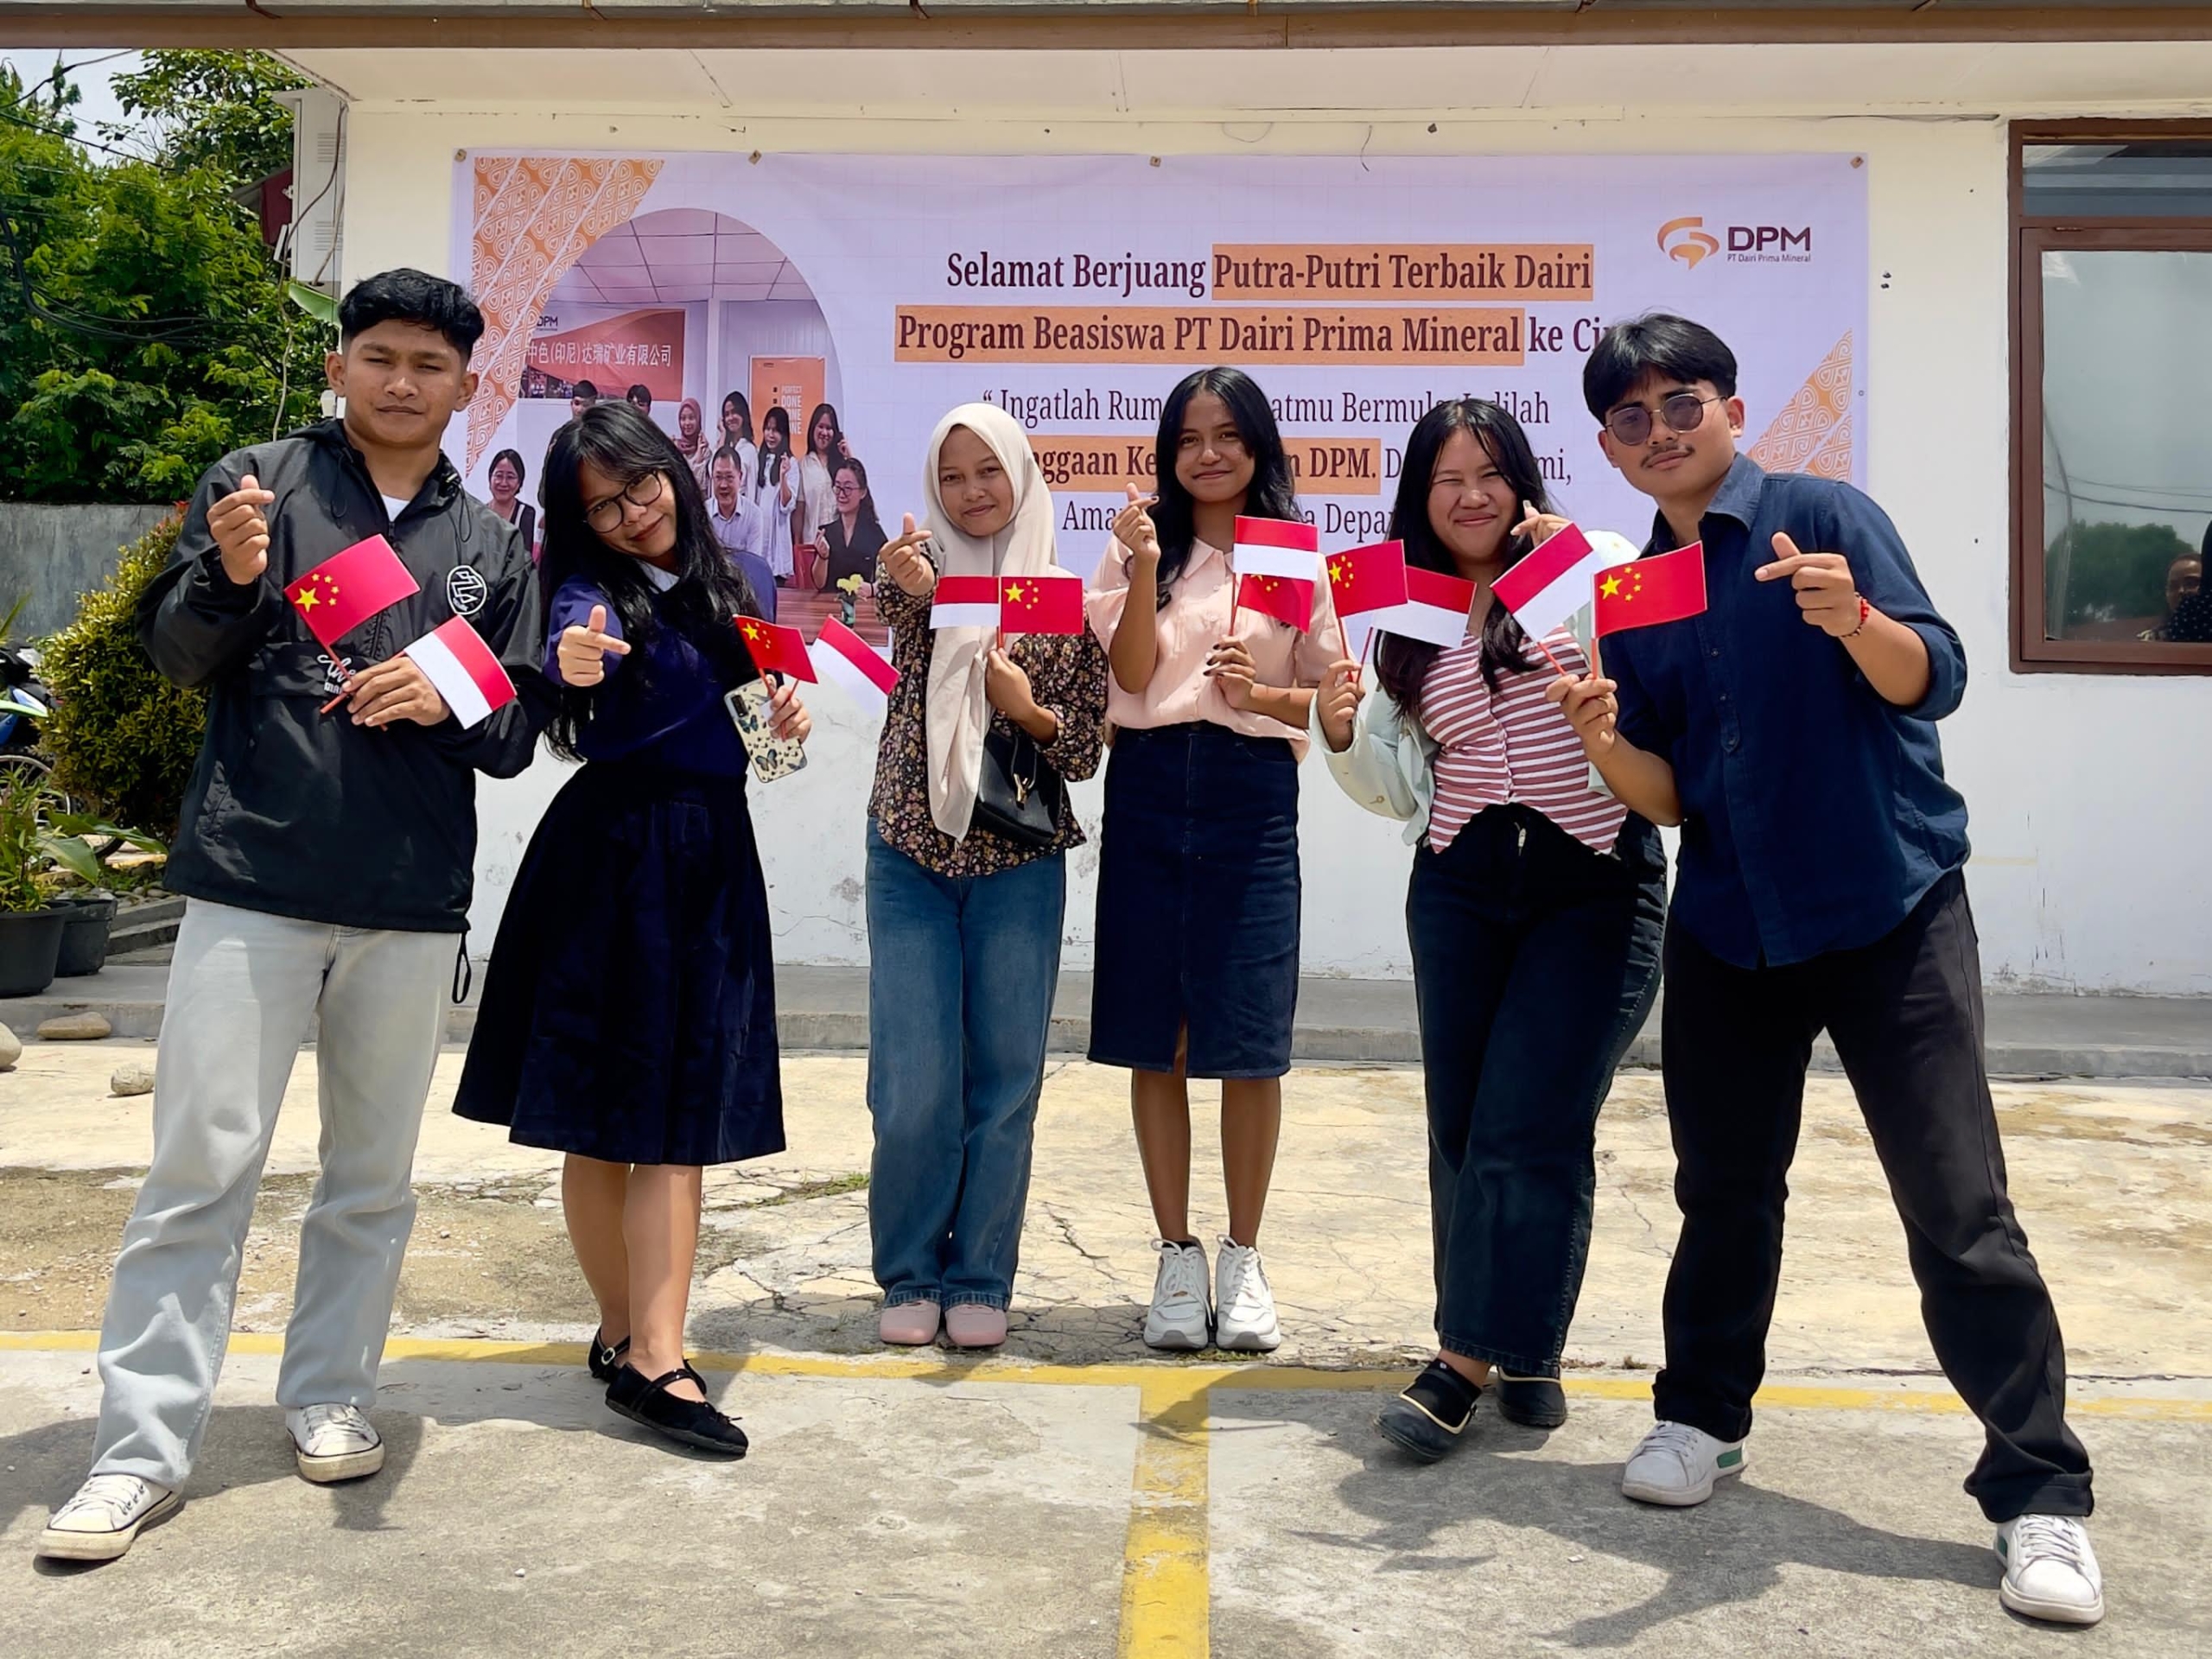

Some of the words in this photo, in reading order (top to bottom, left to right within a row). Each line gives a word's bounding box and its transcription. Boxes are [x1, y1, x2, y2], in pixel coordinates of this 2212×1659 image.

[1728, 226, 1810, 251] DPM
[1782, 253, 1811, 262] Mineral
[947, 251, 1065, 288] Selamat
[1072, 252, 1206, 298] Berjuang
[1213, 252, 1381, 289] Putra-Putri
[1389, 252, 1506, 289] Terbaik
[1514, 252, 1591, 289] Dairi
[899, 315, 1025, 359] Program
[1033, 315, 1166, 350] Beasiswa
[1173, 317, 1211, 351] PT
[1219, 315, 1294, 351] Dairi
[1303, 315, 1393, 352] Prima
[1402, 316, 1521, 352] Mineral
[1528, 316, 1563, 353] ke
[1573, 316, 1609, 353] Ci
[1001, 389, 1100, 429] Ingatlah
[1109, 391, 1161, 421] Rum
[1272, 395, 1333, 422] atmu
[1309, 448, 1376, 479] DPM.
[1325, 504, 1395, 543] Depa
